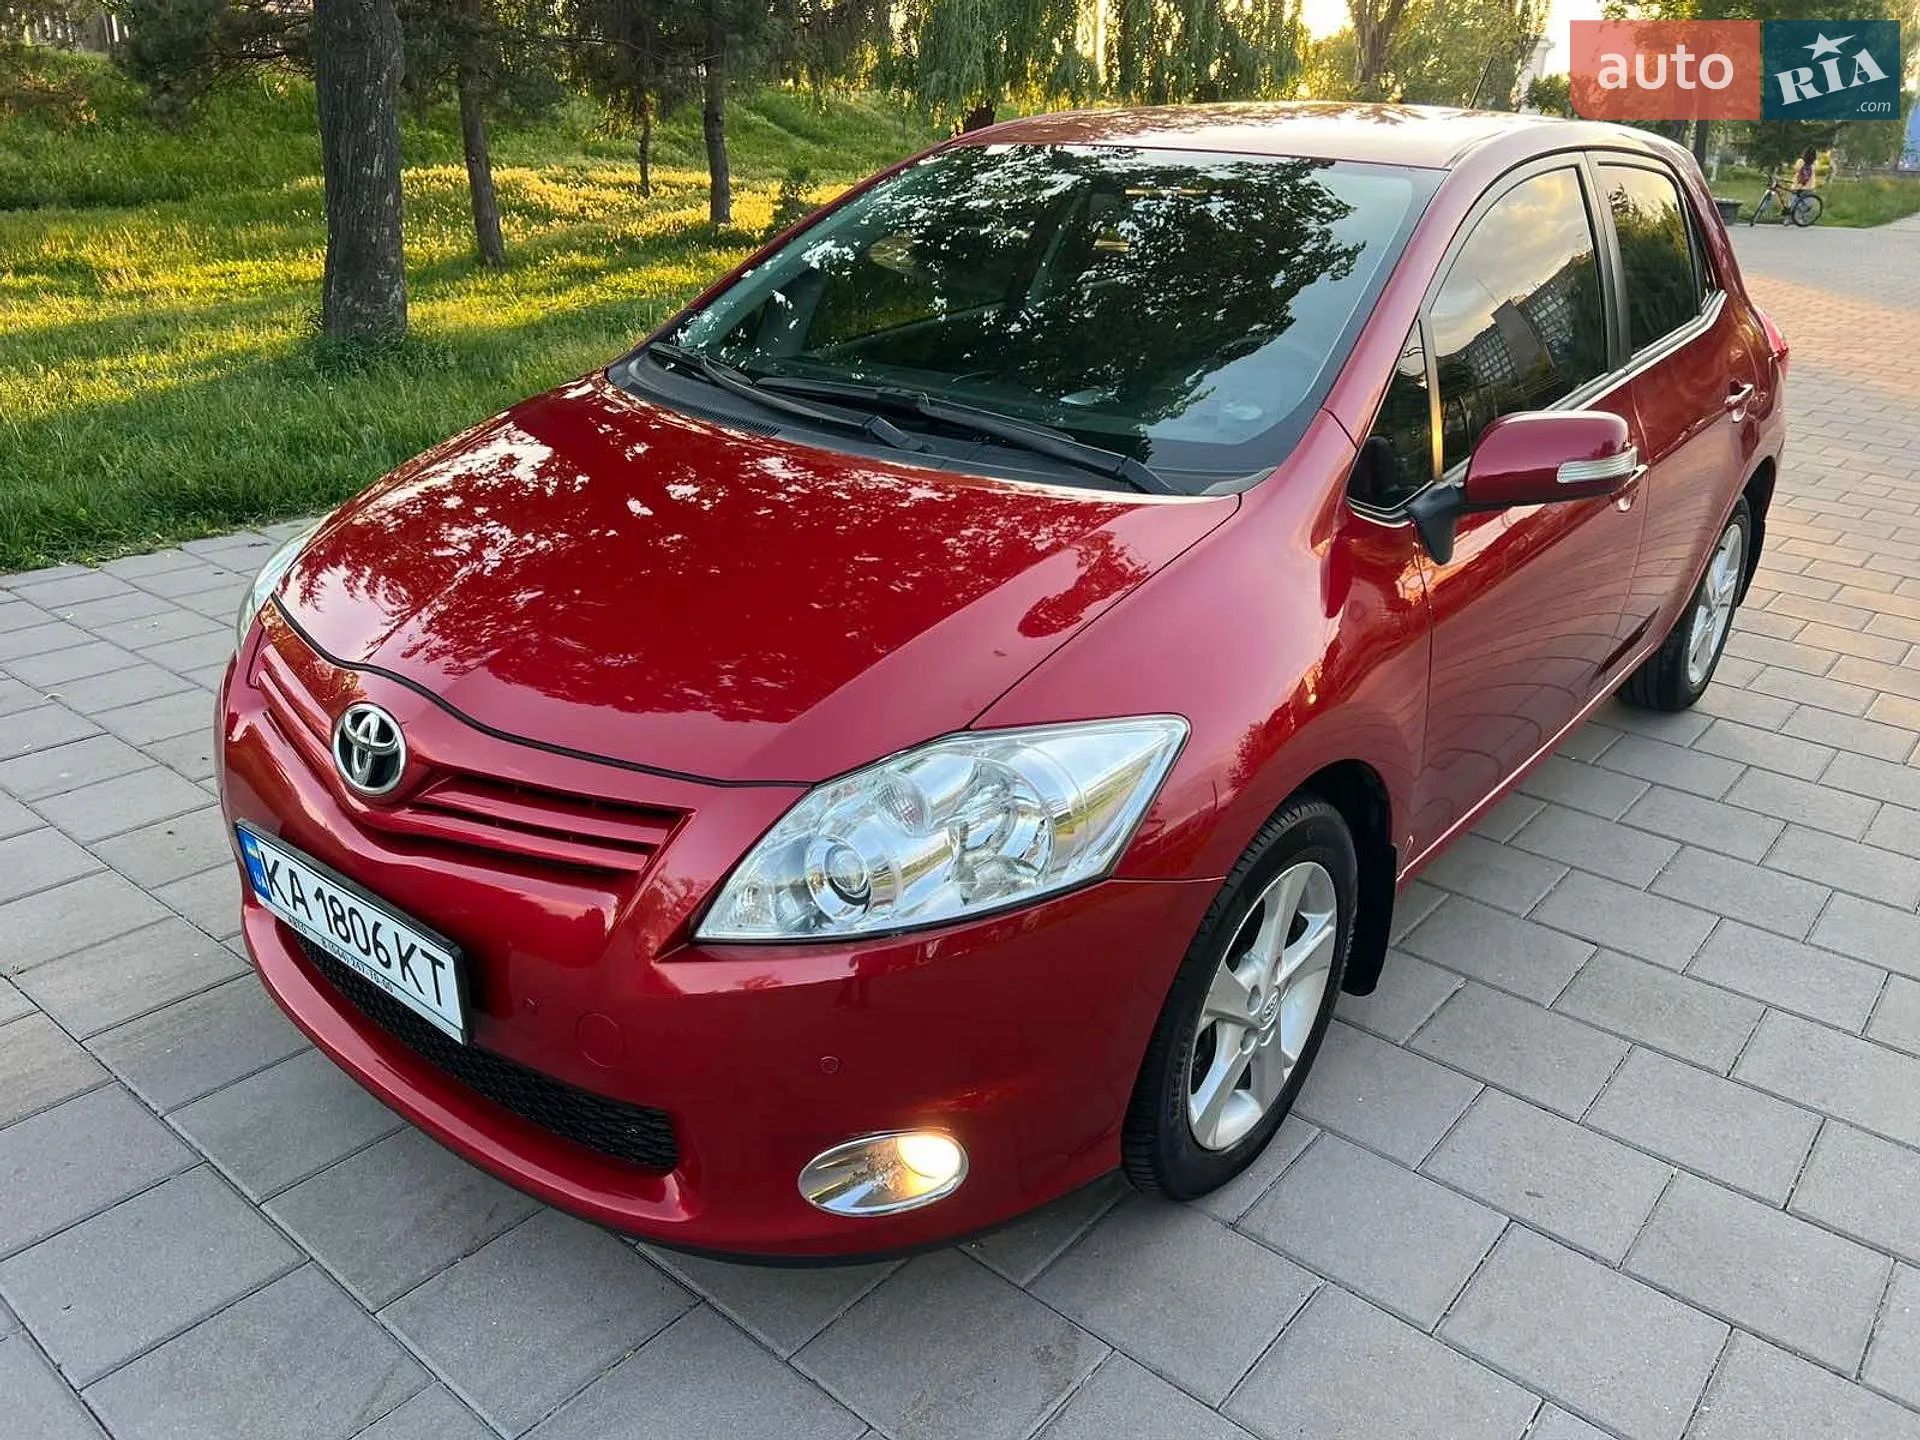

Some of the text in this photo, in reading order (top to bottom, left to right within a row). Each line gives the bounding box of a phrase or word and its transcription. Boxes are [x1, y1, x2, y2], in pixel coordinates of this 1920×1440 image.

[260, 850, 446, 1008] KA 1806 KT
